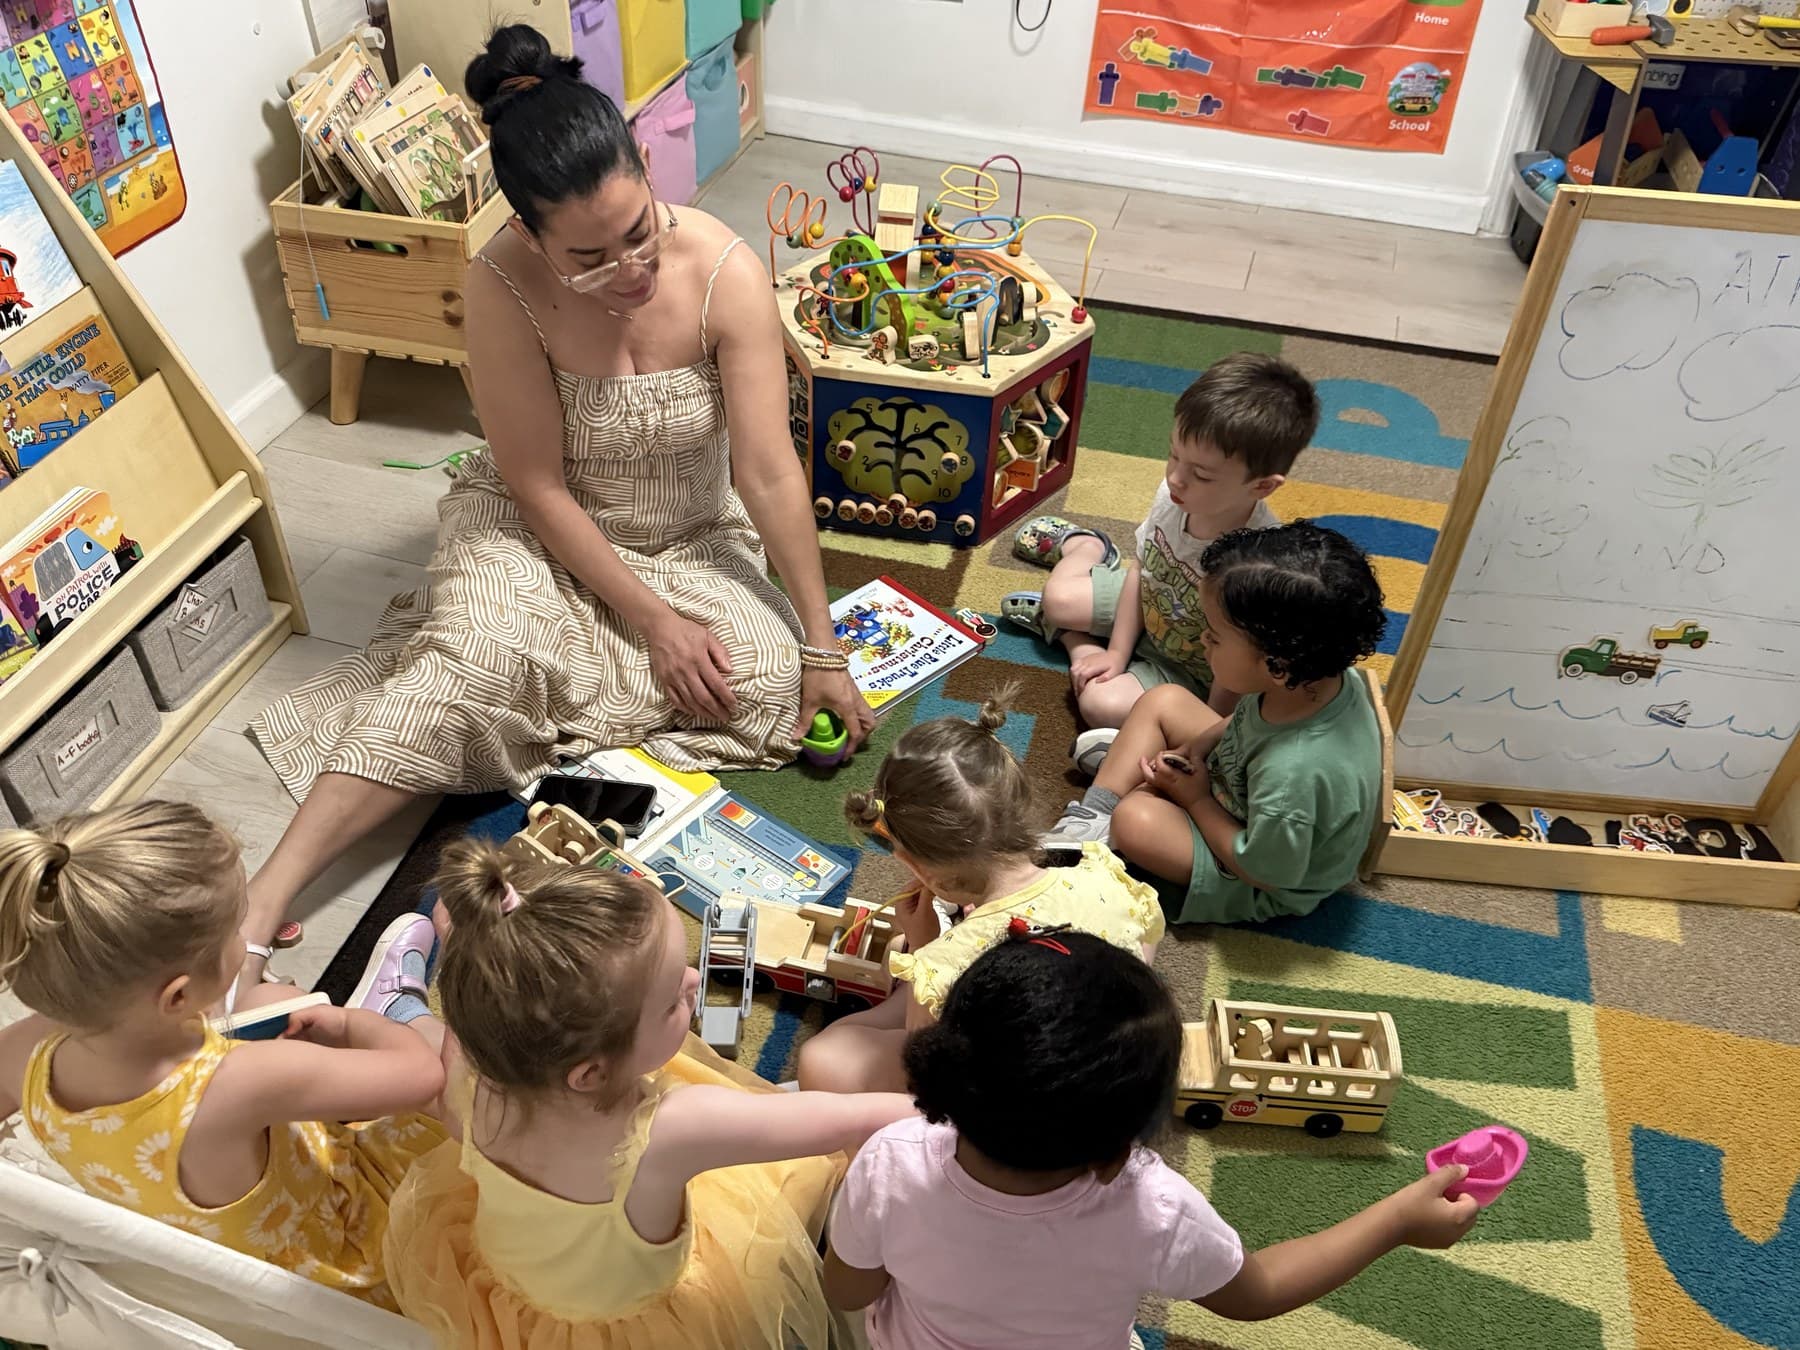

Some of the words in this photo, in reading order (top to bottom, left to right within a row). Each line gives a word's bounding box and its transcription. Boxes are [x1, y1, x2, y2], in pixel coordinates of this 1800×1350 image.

[1414, 12, 1450, 26] Home
[64, 39, 81, 61] N
[32, 54, 51, 77] M
[1388, 119, 1431, 132] School
[12, 353, 55, 389] LITTLE
[55, 323, 101, 360] ENGINE
[15, 378, 48, 407] THAT
[48, 352, 86, 385] COULD
[59, 392, 69, 402] by
[866, 403, 873, 414] 5
[833, 421, 841, 432] 4
[913, 423, 920, 433] 6
[955, 435, 963, 446] 7
[830, 445, 837, 455] 3
[862, 455, 869, 466] 2
[959, 456, 968, 466] 8
[931, 469, 938, 480] 9
[938, 487, 951, 498] 10
[66, 572, 92, 593] PATROL
[91, 560, 108, 578] WITH
[55, 565, 114, 621] POLICE
[78, 590, 101, 612] CAR
[932, 634, 963, 655] Little
[871, 636, 934, 673] Christmas
[914, 652, 940, 670] Blue
[868, 667, 918, 690] Truck's
[1231, 1104, 1257, 1113] STOP
